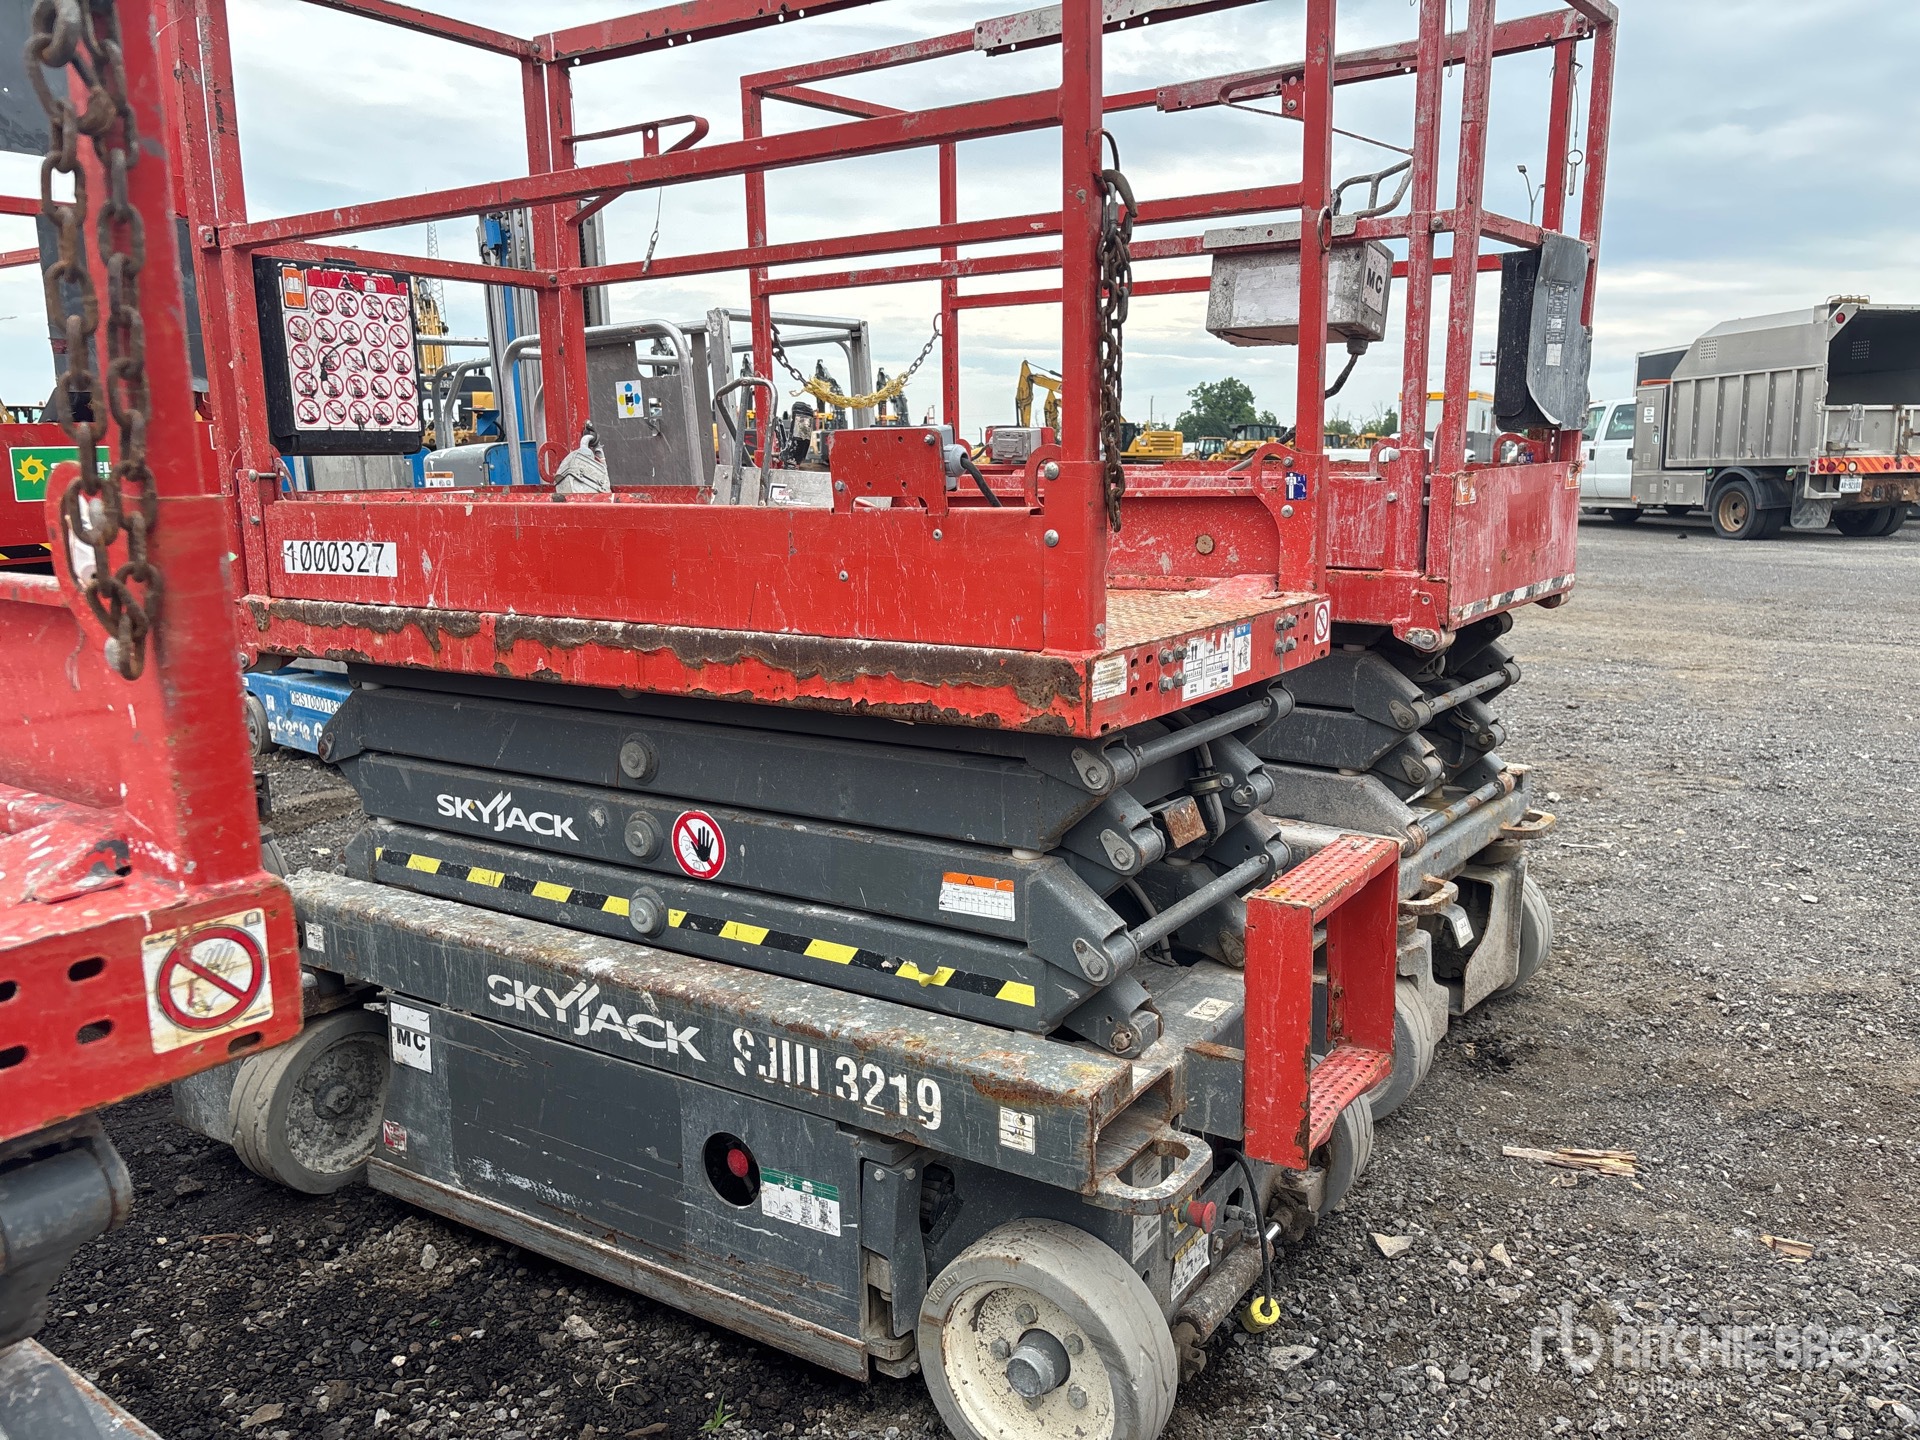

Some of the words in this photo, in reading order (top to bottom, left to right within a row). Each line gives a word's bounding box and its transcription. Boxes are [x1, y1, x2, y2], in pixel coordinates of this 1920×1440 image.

[1366, 267, 1383, 294] MC
[286, 541, 385, 573] 1000327
[436, 790, 580, 841] SKYJACK
[487, 974, 707, 1062] SKYJACK
[396, 1027, 427, 1051] MC
[835, 1056, 942, 1130] 3219
